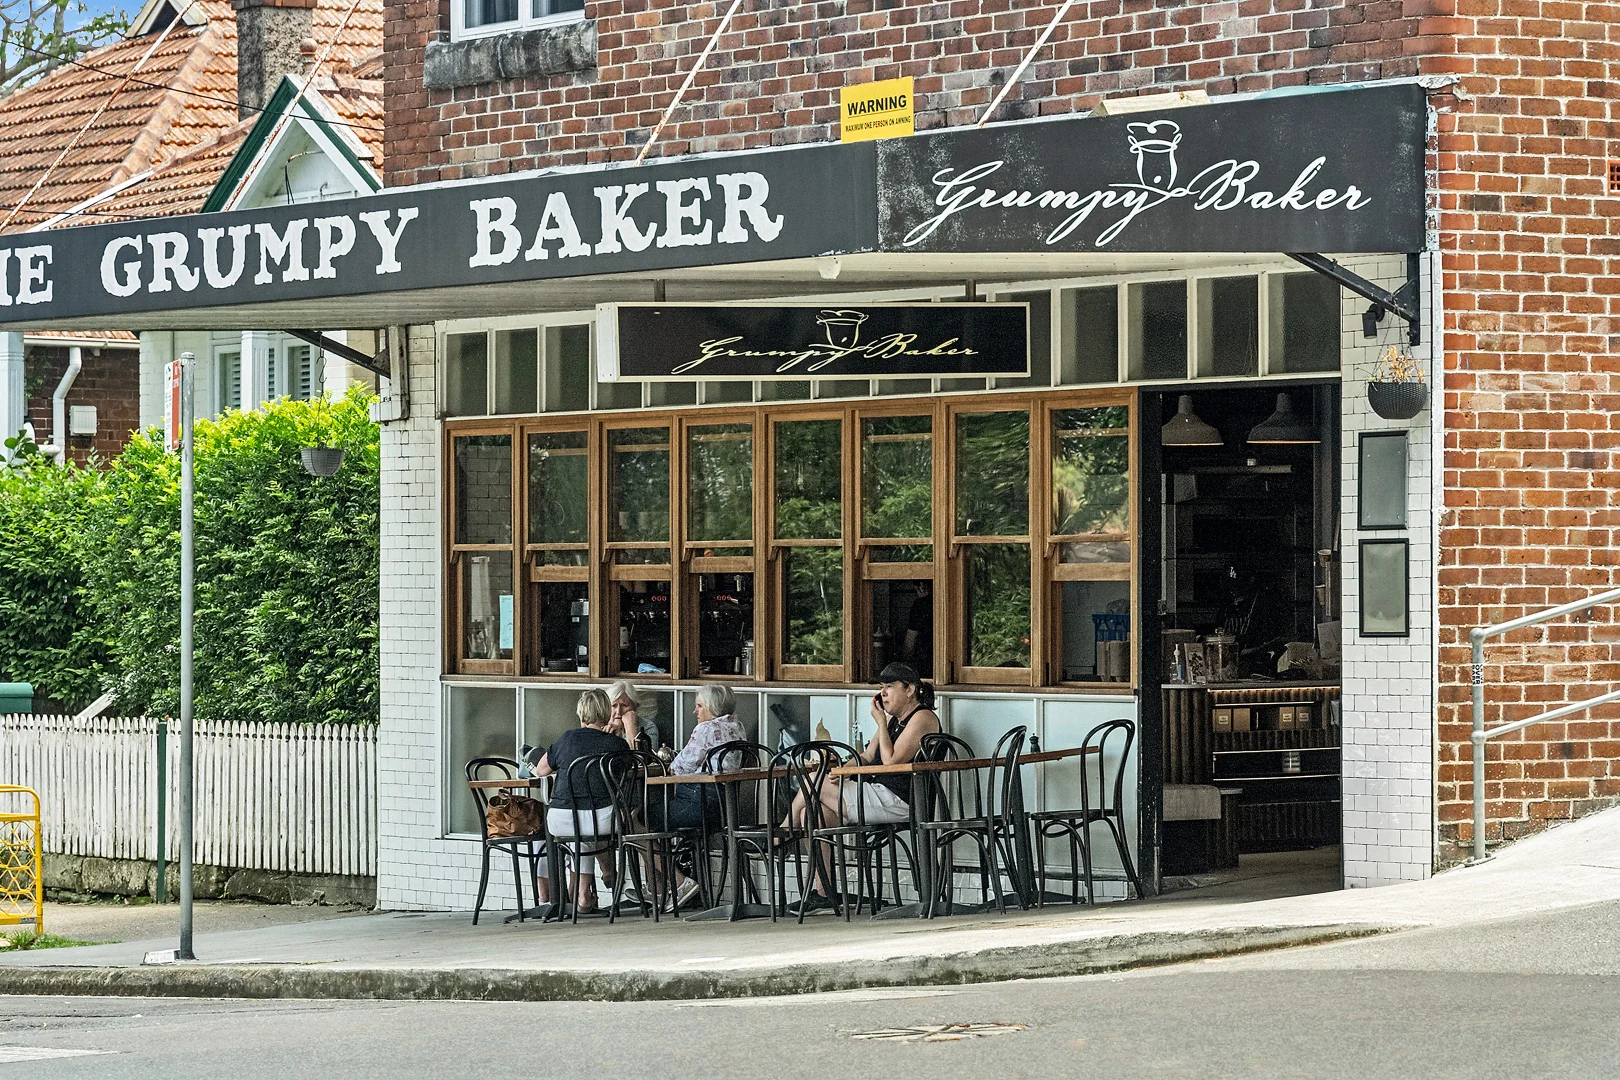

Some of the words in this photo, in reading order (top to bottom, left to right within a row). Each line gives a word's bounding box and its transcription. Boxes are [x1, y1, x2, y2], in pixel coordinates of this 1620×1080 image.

[845, 122, 864, 132] MAXIMUM
[864, 121, 873, 130] ONE
[873, 119, 889, 128] PERSON
[889, 118, 895, 126] ON
[895, 115, 911, 125] AWNING
[847, 94, 907, 115] WARNING
[902, 160, 1181, 247] Grumpy
[1185, 156, 1372, 211] Baker
[0, 244, 53, 306] E
[100, 206, 419, 298] GRUMPY
[469, 171, 785, 269] BAKER
[671, 335, 866, 375] Grumpy
[865, 332, 979, 359] Baker
